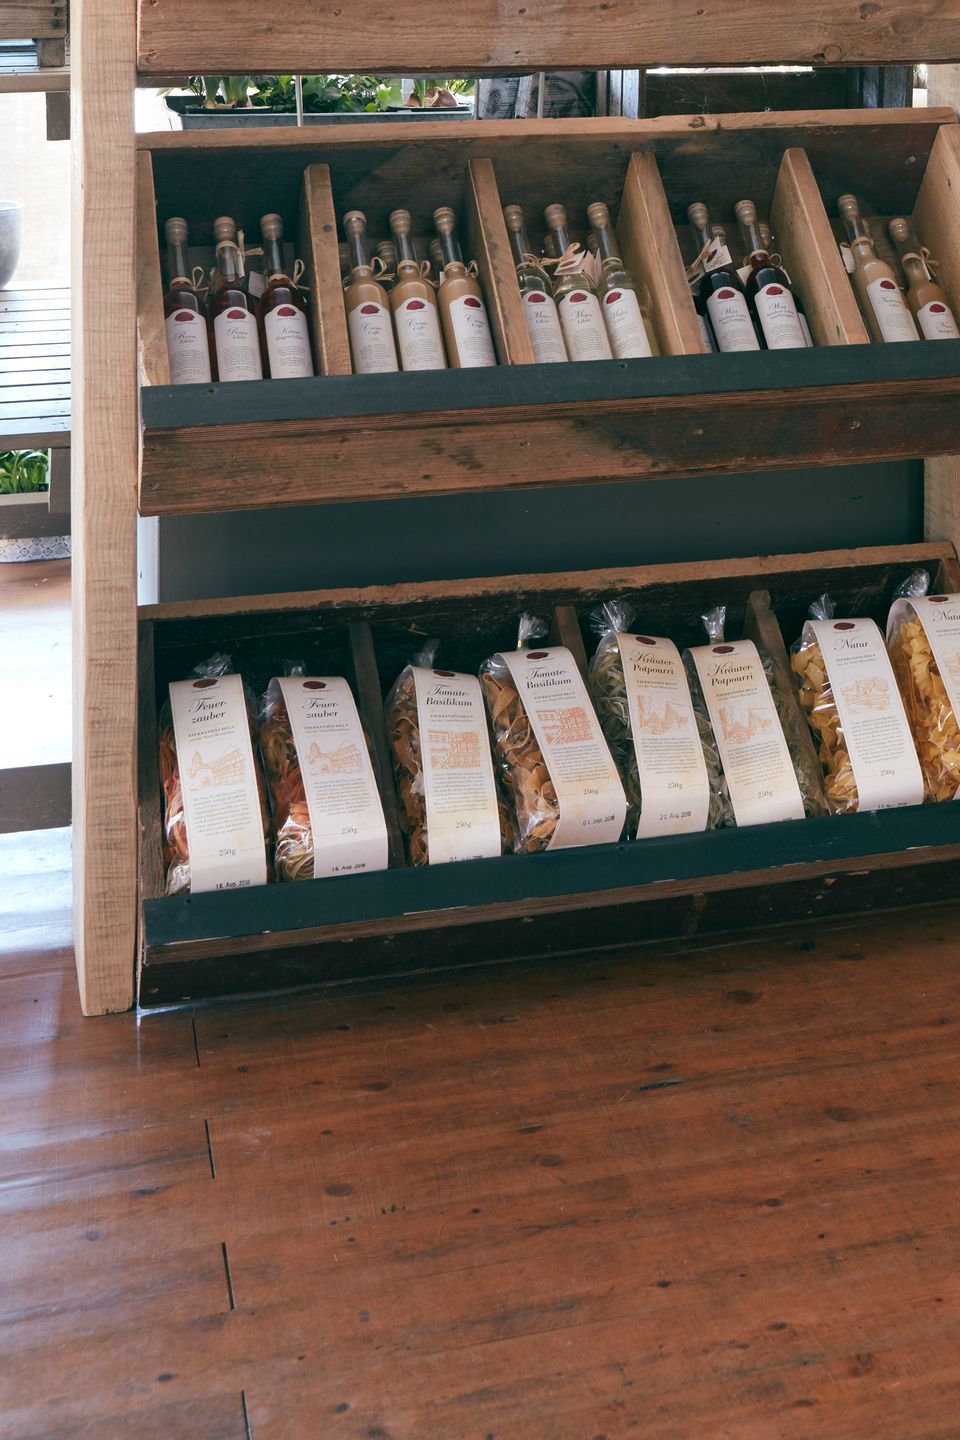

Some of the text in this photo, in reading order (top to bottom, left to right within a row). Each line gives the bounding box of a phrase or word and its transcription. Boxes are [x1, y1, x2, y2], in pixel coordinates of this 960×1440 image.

[833, 637, 869, 651] Natur
[630, 650, 675, 666] Kräuter-
[525, 666, 567, 679] Tomate-
[633, 664, 674, 675] Potpourri
[707, 662, 754, 677] Kräuter-
[526, 678, 572, 689] Basilikum
[711, 673, 753, 687] Potpourri
[427, 683, 470, 697] Tomate-
[188, 697, 227, 712] Feuer-
[301, 697, 339, 709] Feuer-
[426, 696, 473, 707] Basilikum
[192, 711, 226, 724] zauber
[306, 709, 339, 719] zauber
